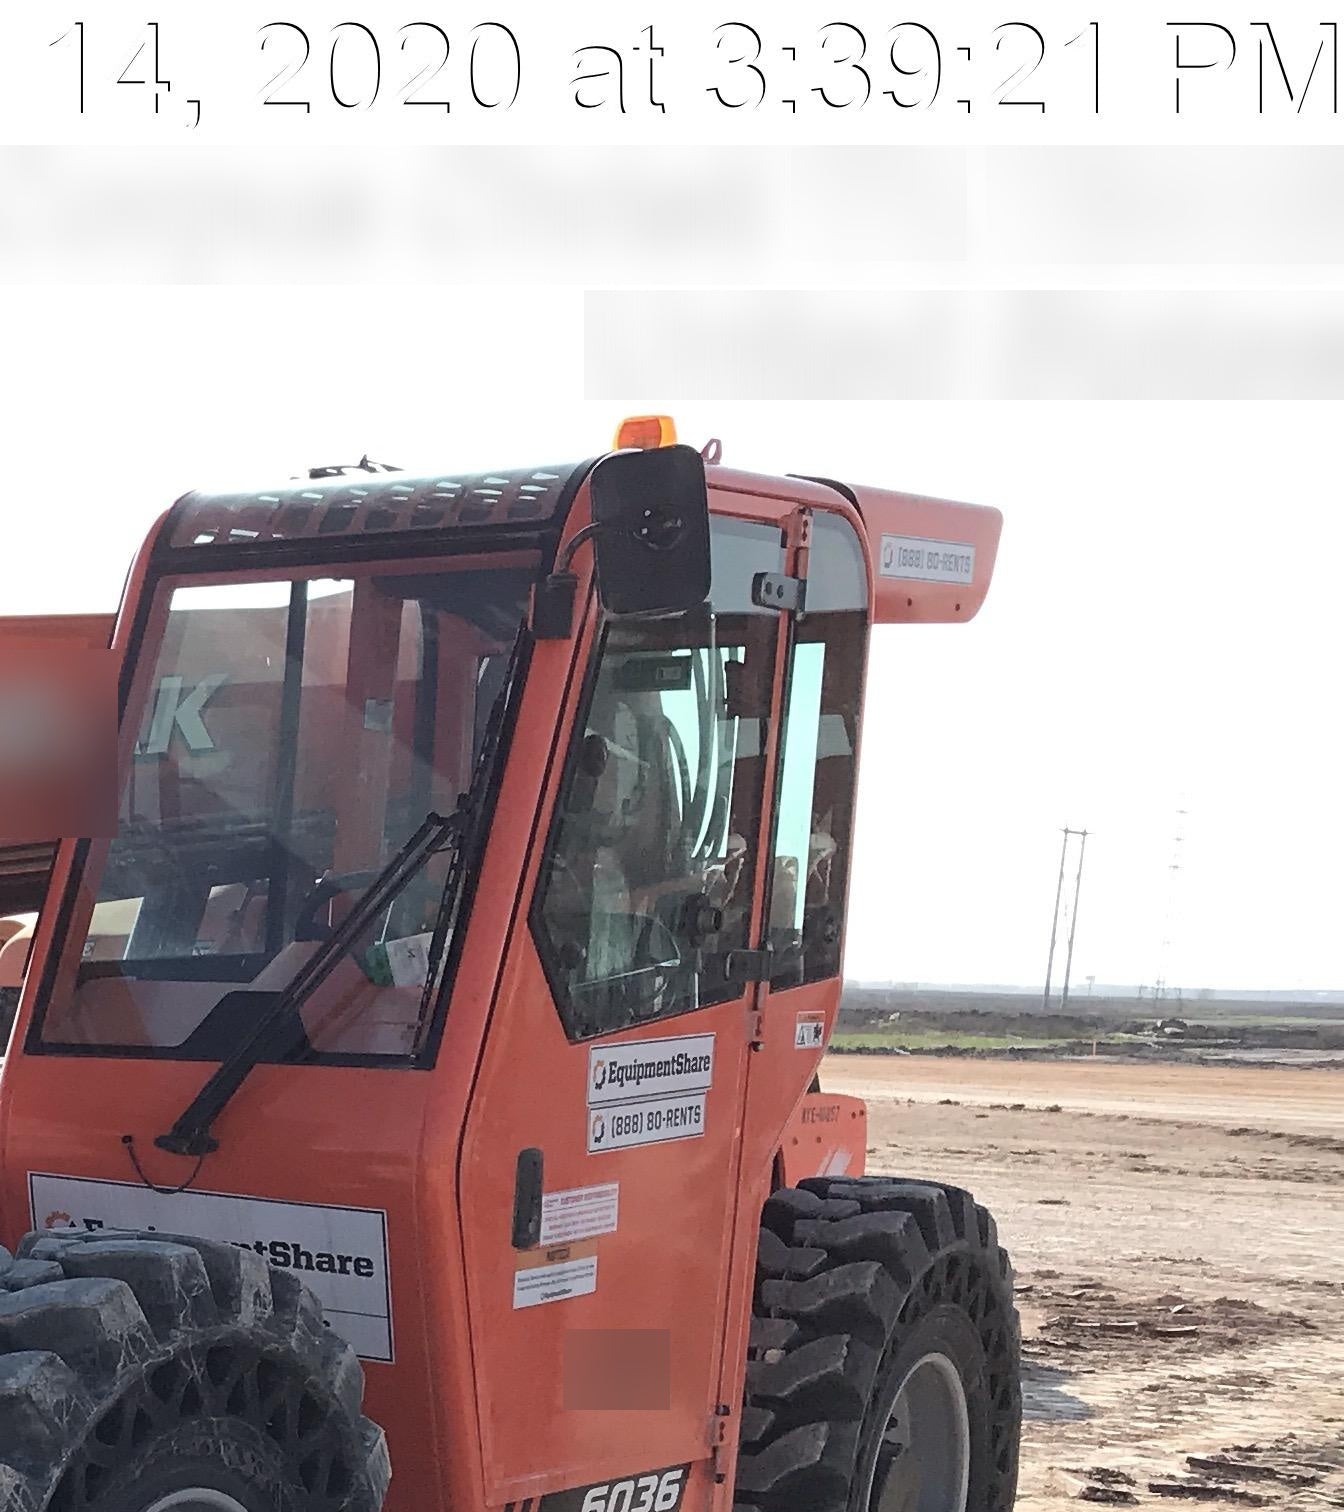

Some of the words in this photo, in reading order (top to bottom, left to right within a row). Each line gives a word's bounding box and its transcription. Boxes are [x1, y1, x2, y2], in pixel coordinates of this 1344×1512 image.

[607, 1053, 711, 1087] EquipmentShare
[611, 1112, 644, 1138] (888)
[646, 1105, 701, 1131] 80-RENTS
